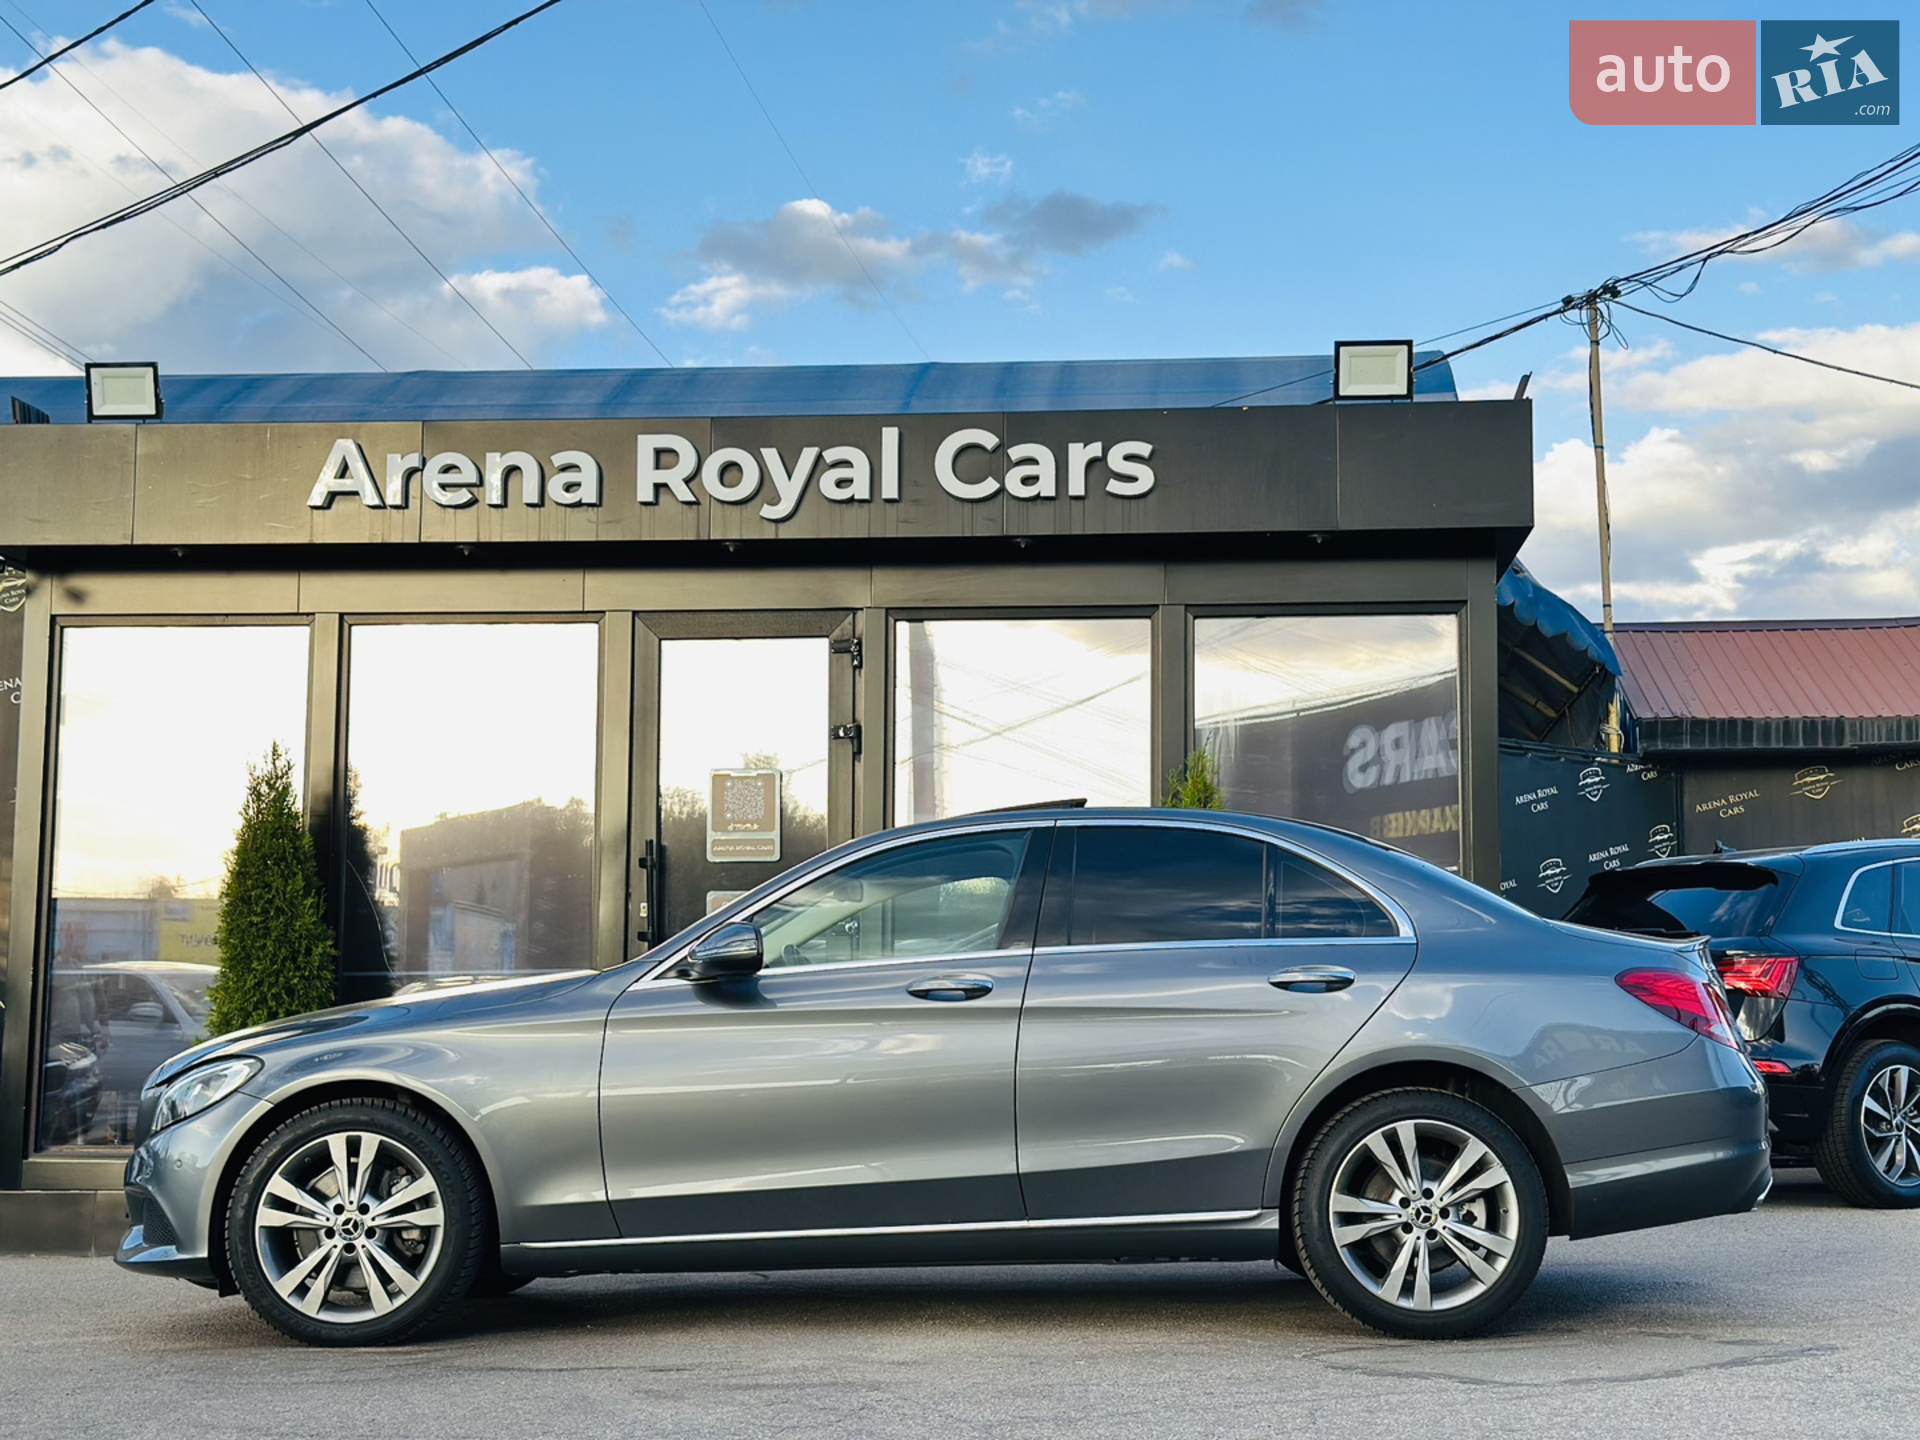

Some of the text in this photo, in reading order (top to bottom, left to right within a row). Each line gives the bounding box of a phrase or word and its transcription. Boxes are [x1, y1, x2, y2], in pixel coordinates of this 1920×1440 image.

[307, 426, 1157, 521] Arena Royal Cars
[1515, 786, 1559, 805] ARENA ROYAL
[1695, 789, 1760, 813] ARENA ROYAL
[1531, 801, 1549, 813] CARS
[1719, 805, 1745, 818] CARS
[1588, 843, 1630, 863] ARENA ROYAL
[1603, 858, 1621, 870] CARS
